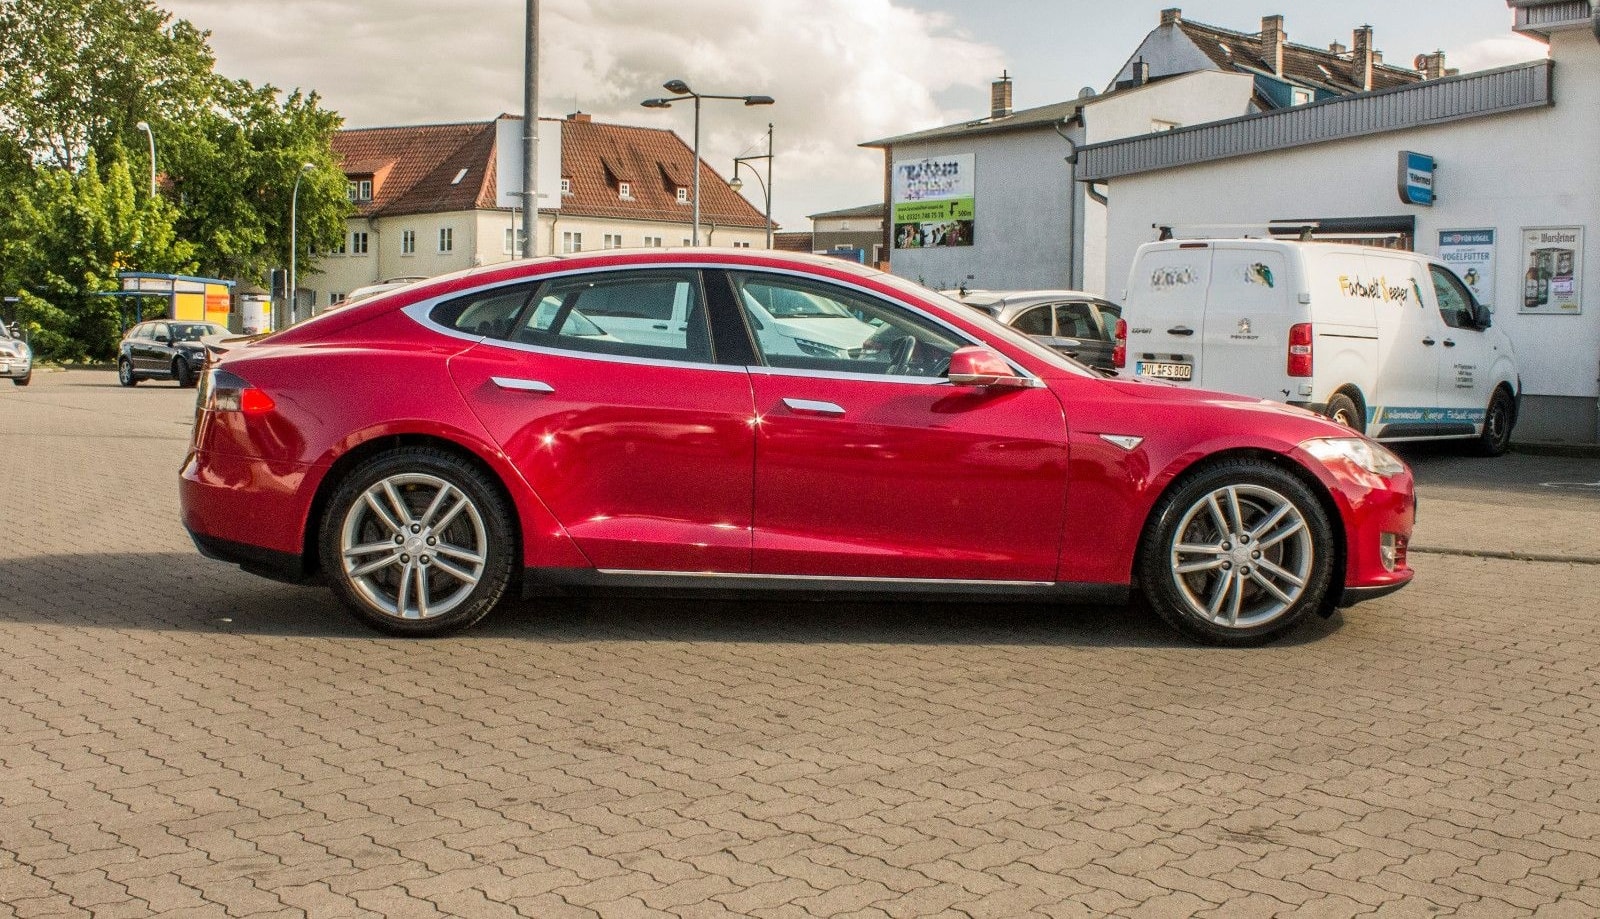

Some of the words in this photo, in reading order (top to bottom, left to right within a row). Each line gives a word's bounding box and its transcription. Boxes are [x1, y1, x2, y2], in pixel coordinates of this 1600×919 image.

[1541, 232, 1576, 243] Warsteiner
[1142, 364, 1156, 375] HVL
[1162, 365, 1172, 376] FS
[1175, 366, 1190, 377] 800
